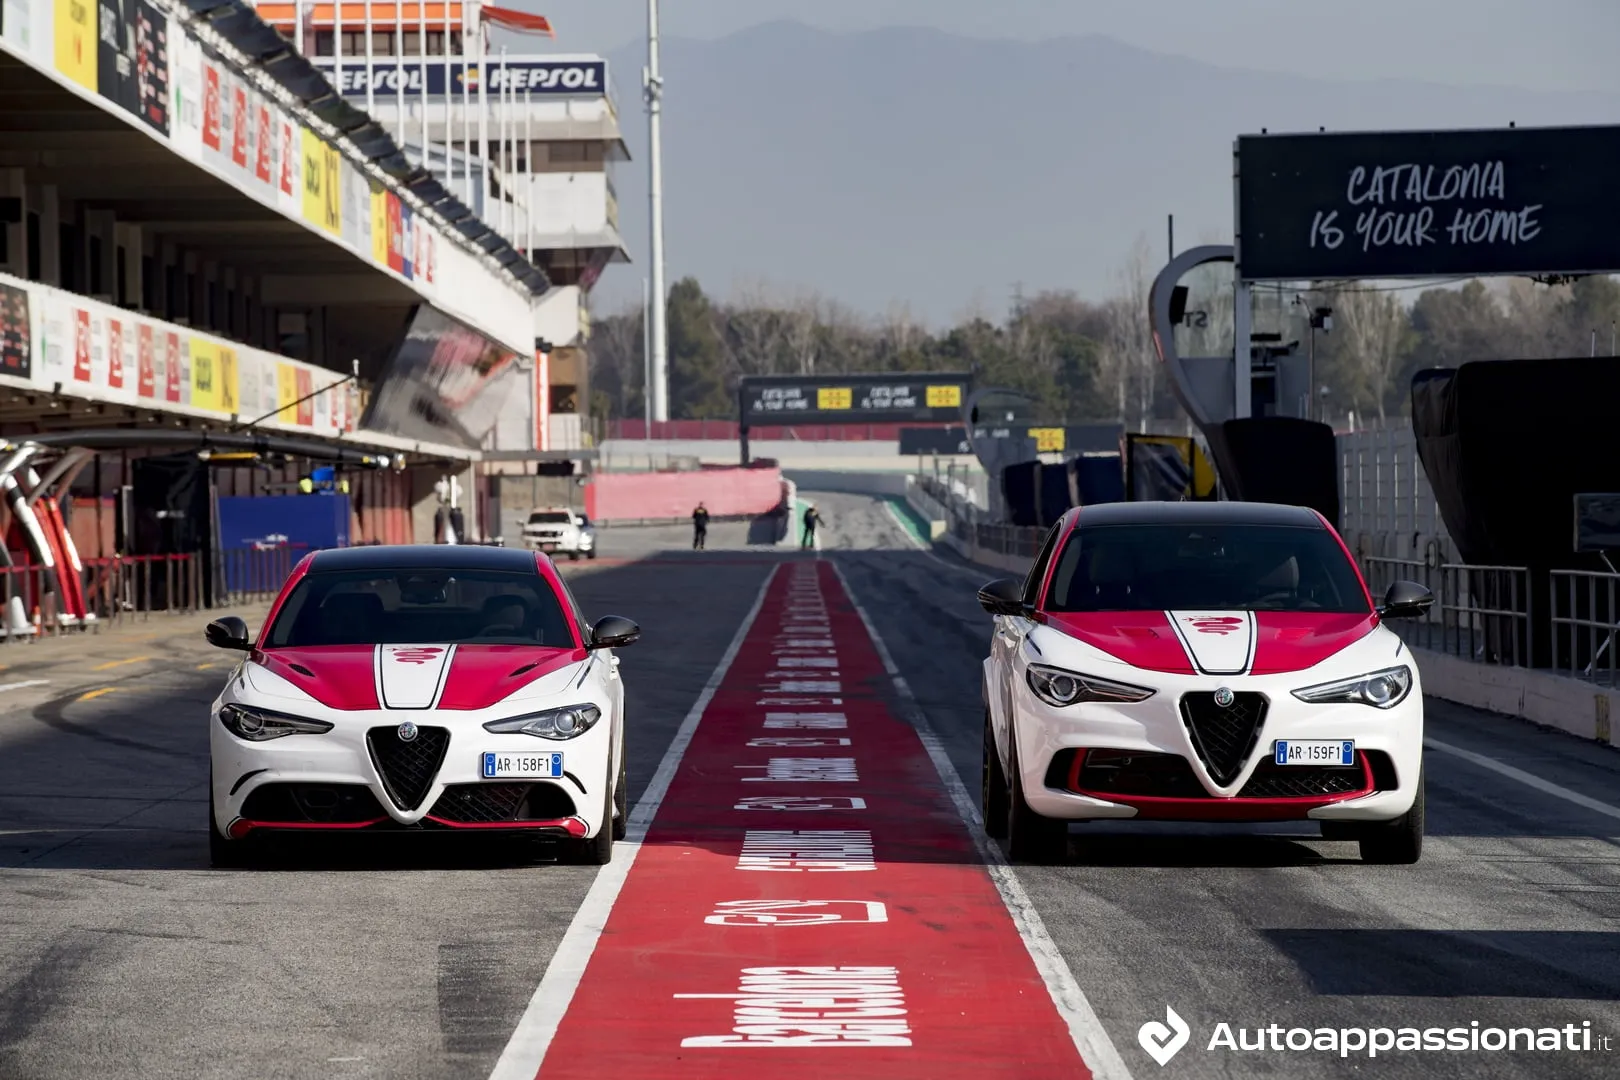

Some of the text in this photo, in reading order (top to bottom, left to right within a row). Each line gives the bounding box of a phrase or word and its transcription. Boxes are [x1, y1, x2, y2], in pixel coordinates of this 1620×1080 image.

[489, 68, 598, 88] REPSOL
[1347, 161, 1504, 205] CATALONIA
[1310, 203, 1542, 252] IS YOUR HOME
[497, 758, 549, 772] AR 158F1
[1288, 746, 1340, 760] AR 159F1
[674, 966, 913, 1048] Barcelona
